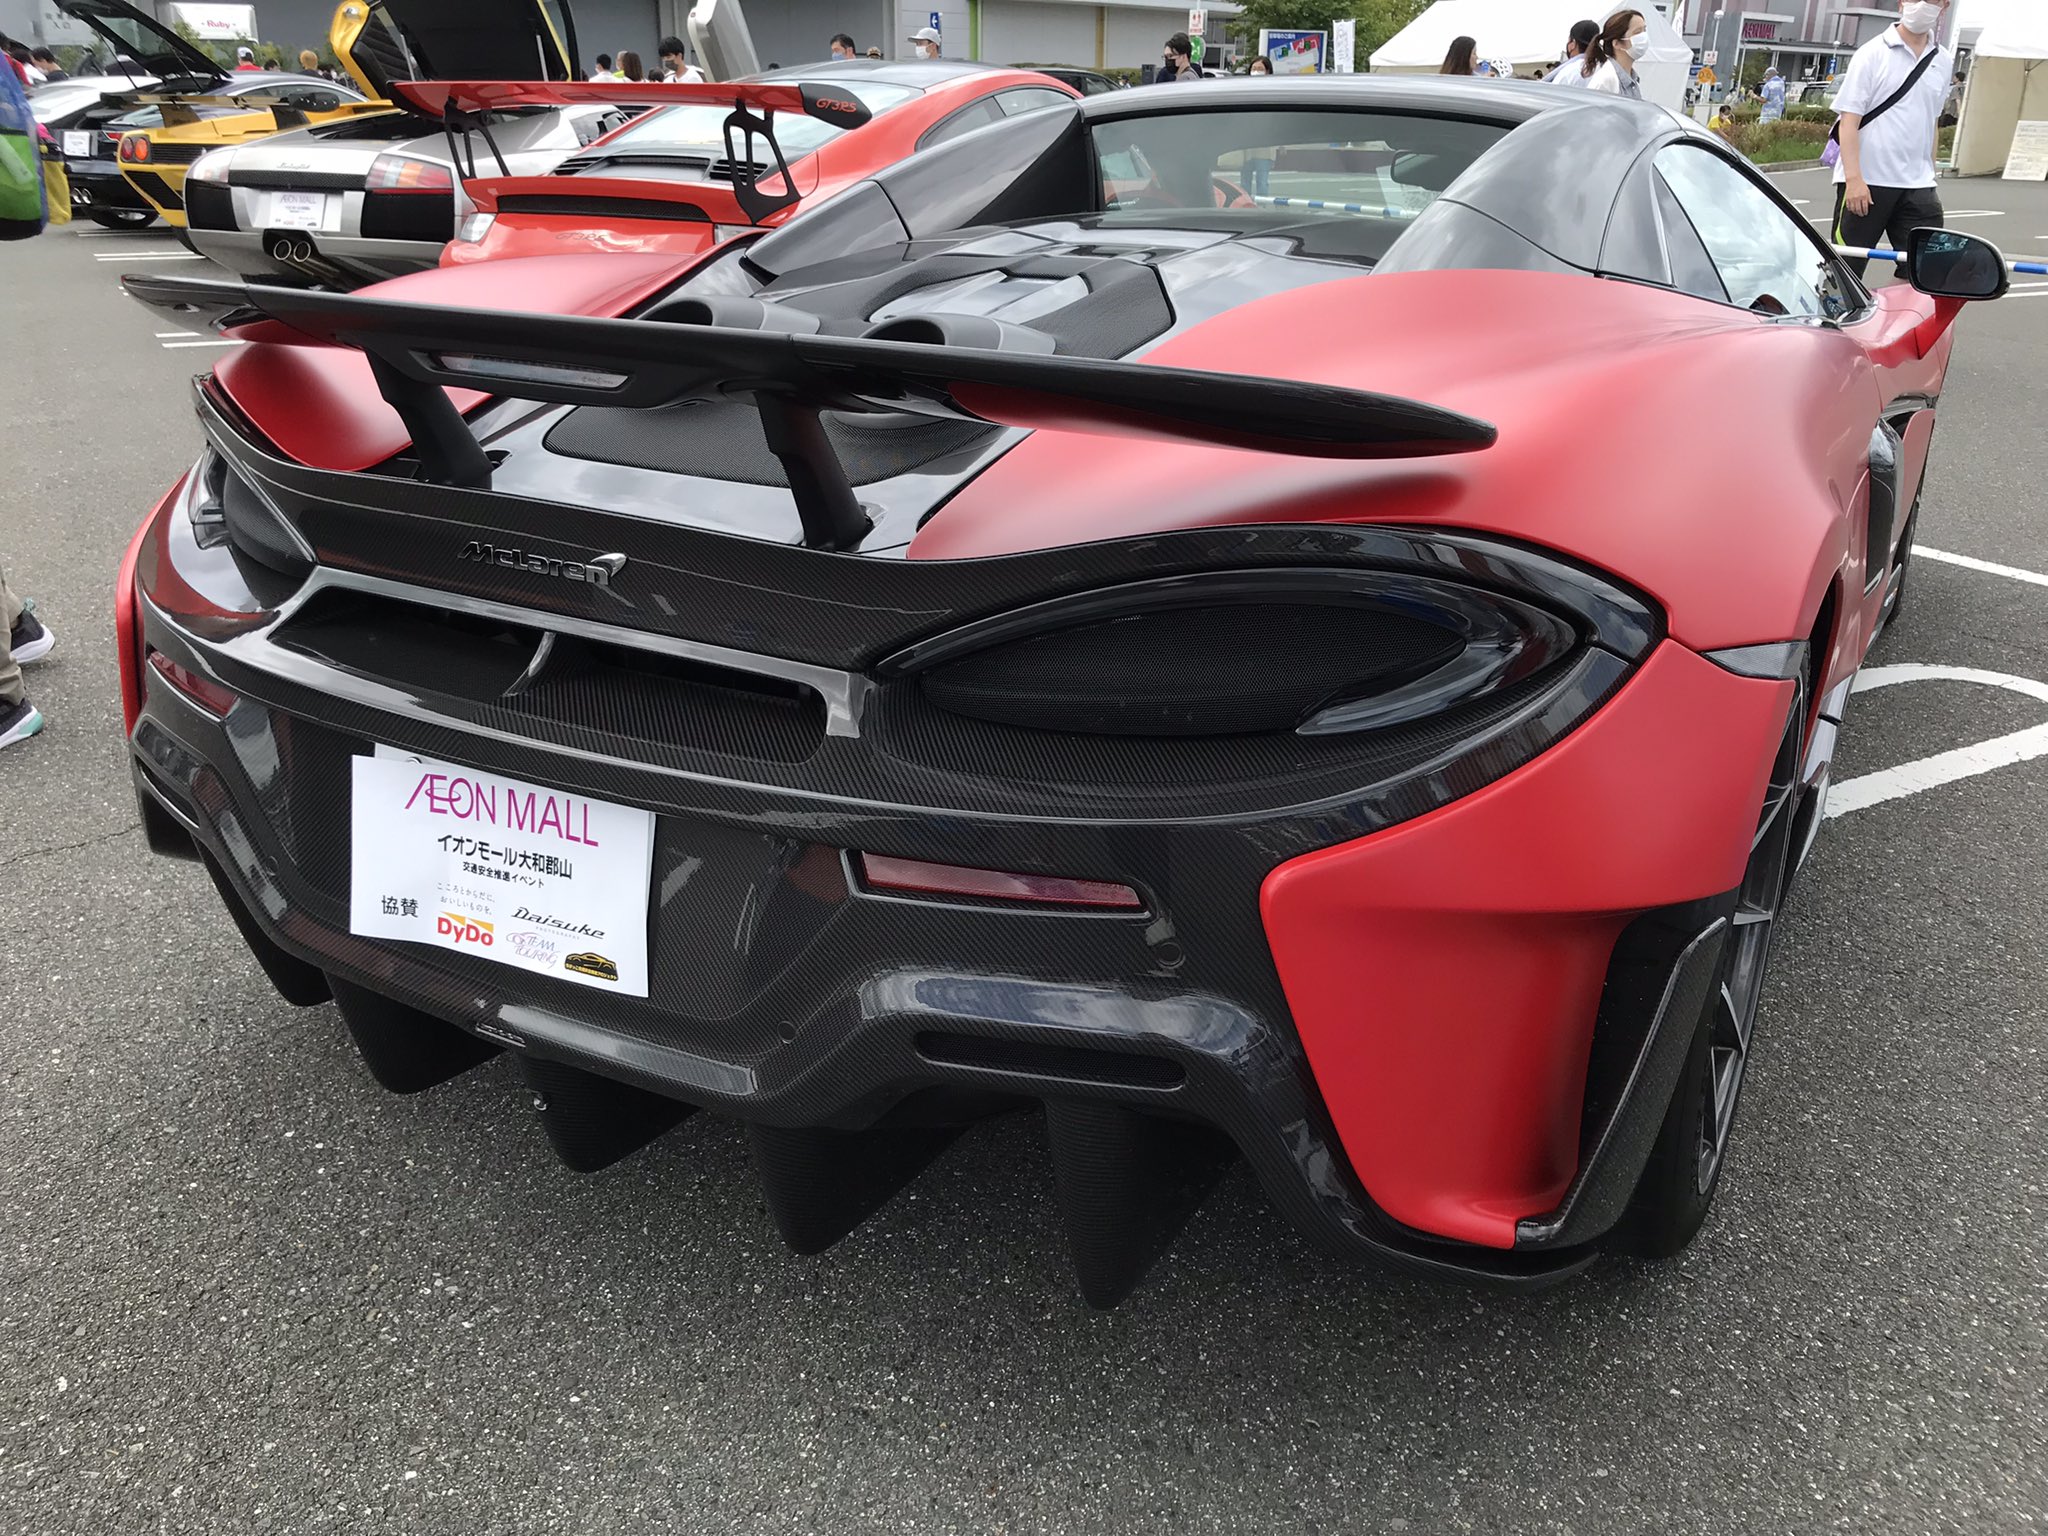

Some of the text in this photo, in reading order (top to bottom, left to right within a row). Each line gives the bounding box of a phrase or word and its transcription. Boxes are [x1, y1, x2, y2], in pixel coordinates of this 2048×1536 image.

[207, 19, 230, 30] Ruby
[457, 540, 610, 586] McLaren
[507, 788, 599, 848] MALL
[437, 834, 573, 880] イオンモール大和郡山
[462, 861, 545, 889] 交通安全推進イベント
[381, 894, 419, 919] 協賛
[437, 916, 495, 946] DyDo
[511, 906, 606, 940] Daisuke
